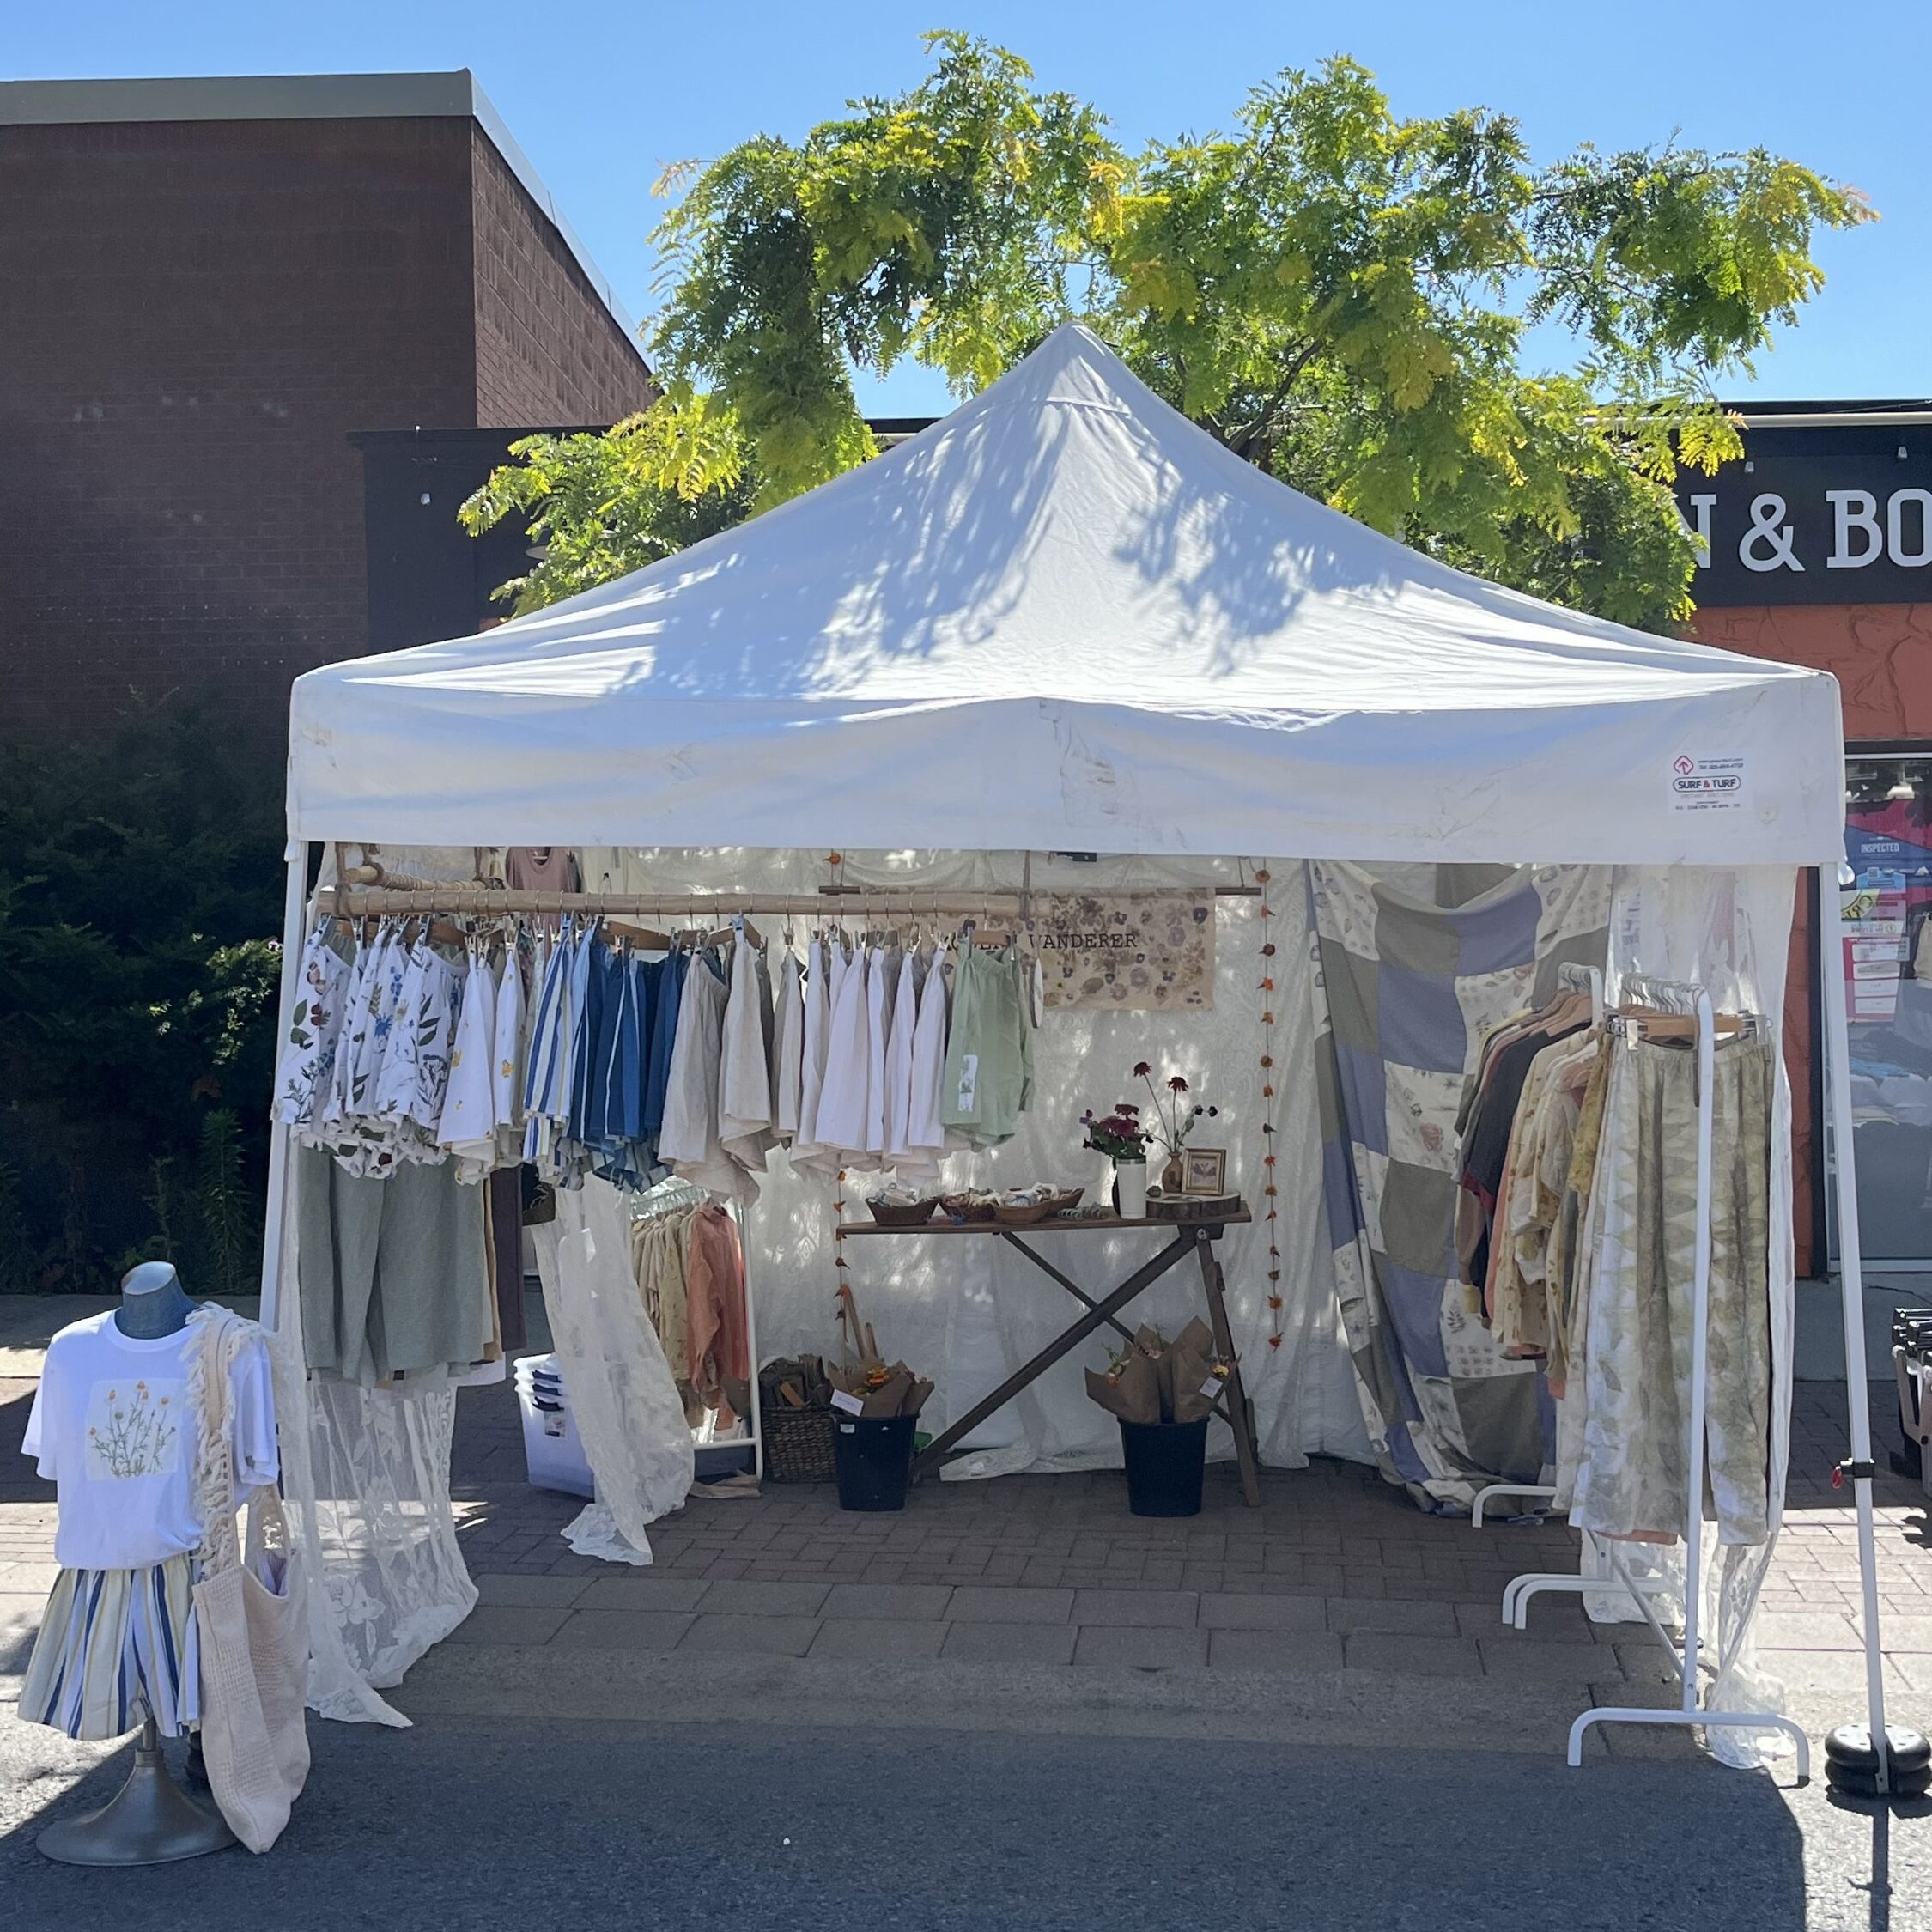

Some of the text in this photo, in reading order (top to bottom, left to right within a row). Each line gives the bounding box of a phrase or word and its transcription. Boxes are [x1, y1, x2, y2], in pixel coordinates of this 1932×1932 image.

[1739, 493, 1806, 572] &
[1826, 489, 1932, 568] BO
[1678, 778, 1736, 789] SURF & TURF
[1861, 842, 1899, 854] INSPECTED
